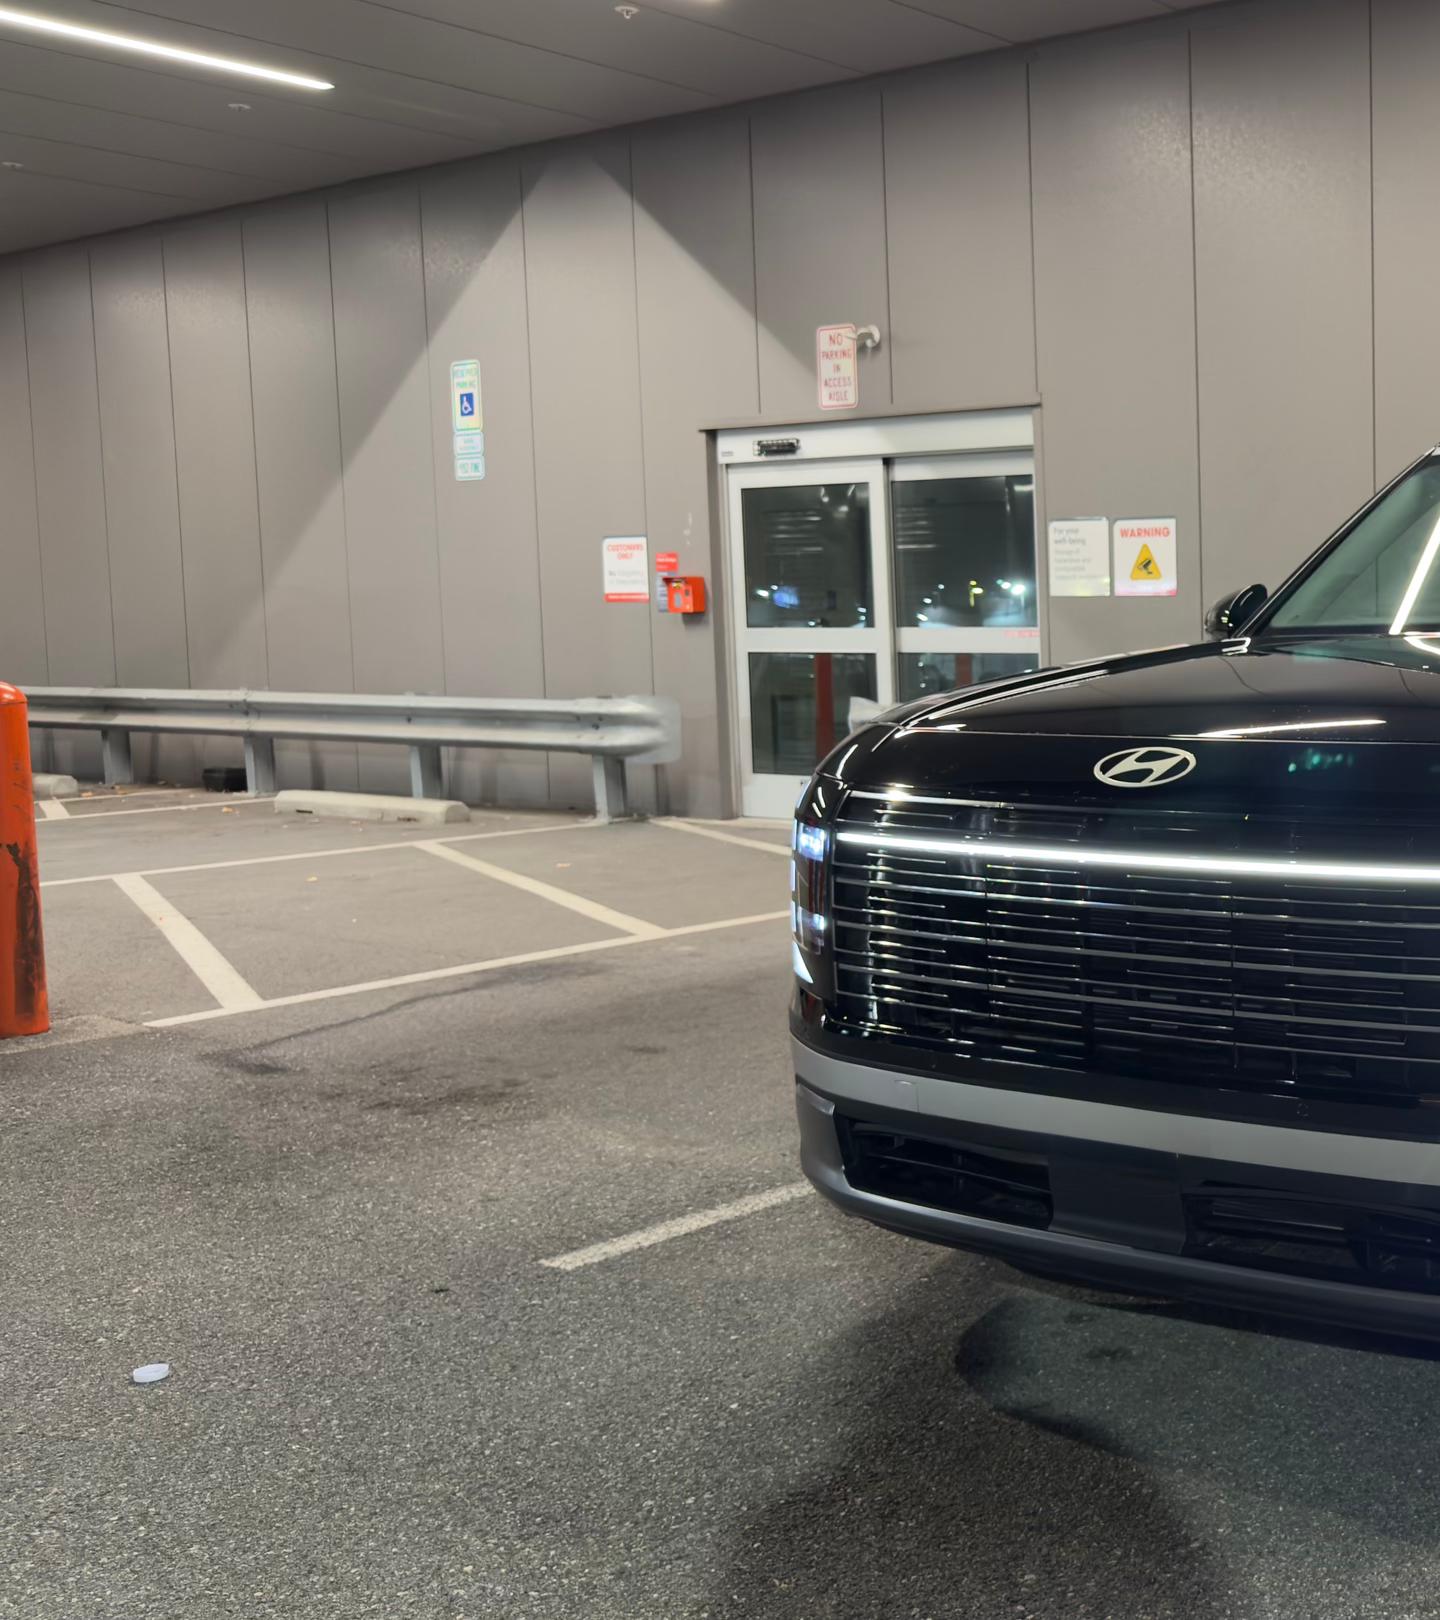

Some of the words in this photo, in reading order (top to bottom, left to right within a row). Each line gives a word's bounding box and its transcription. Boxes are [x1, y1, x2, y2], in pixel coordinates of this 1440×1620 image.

[830, 335, 843, 346] NO
[822, 349, 852, 360] PARKING
[832, 364, 840, 373] IN
[824, 377, 851, 387] ACCESS
[828, 391, 848, 401] AISLE
[1120, 527, 1170, 538] WARNING
[607, 544, 644, 552] CUSTOMERS
[617, 552, 633, 560] ONLY
